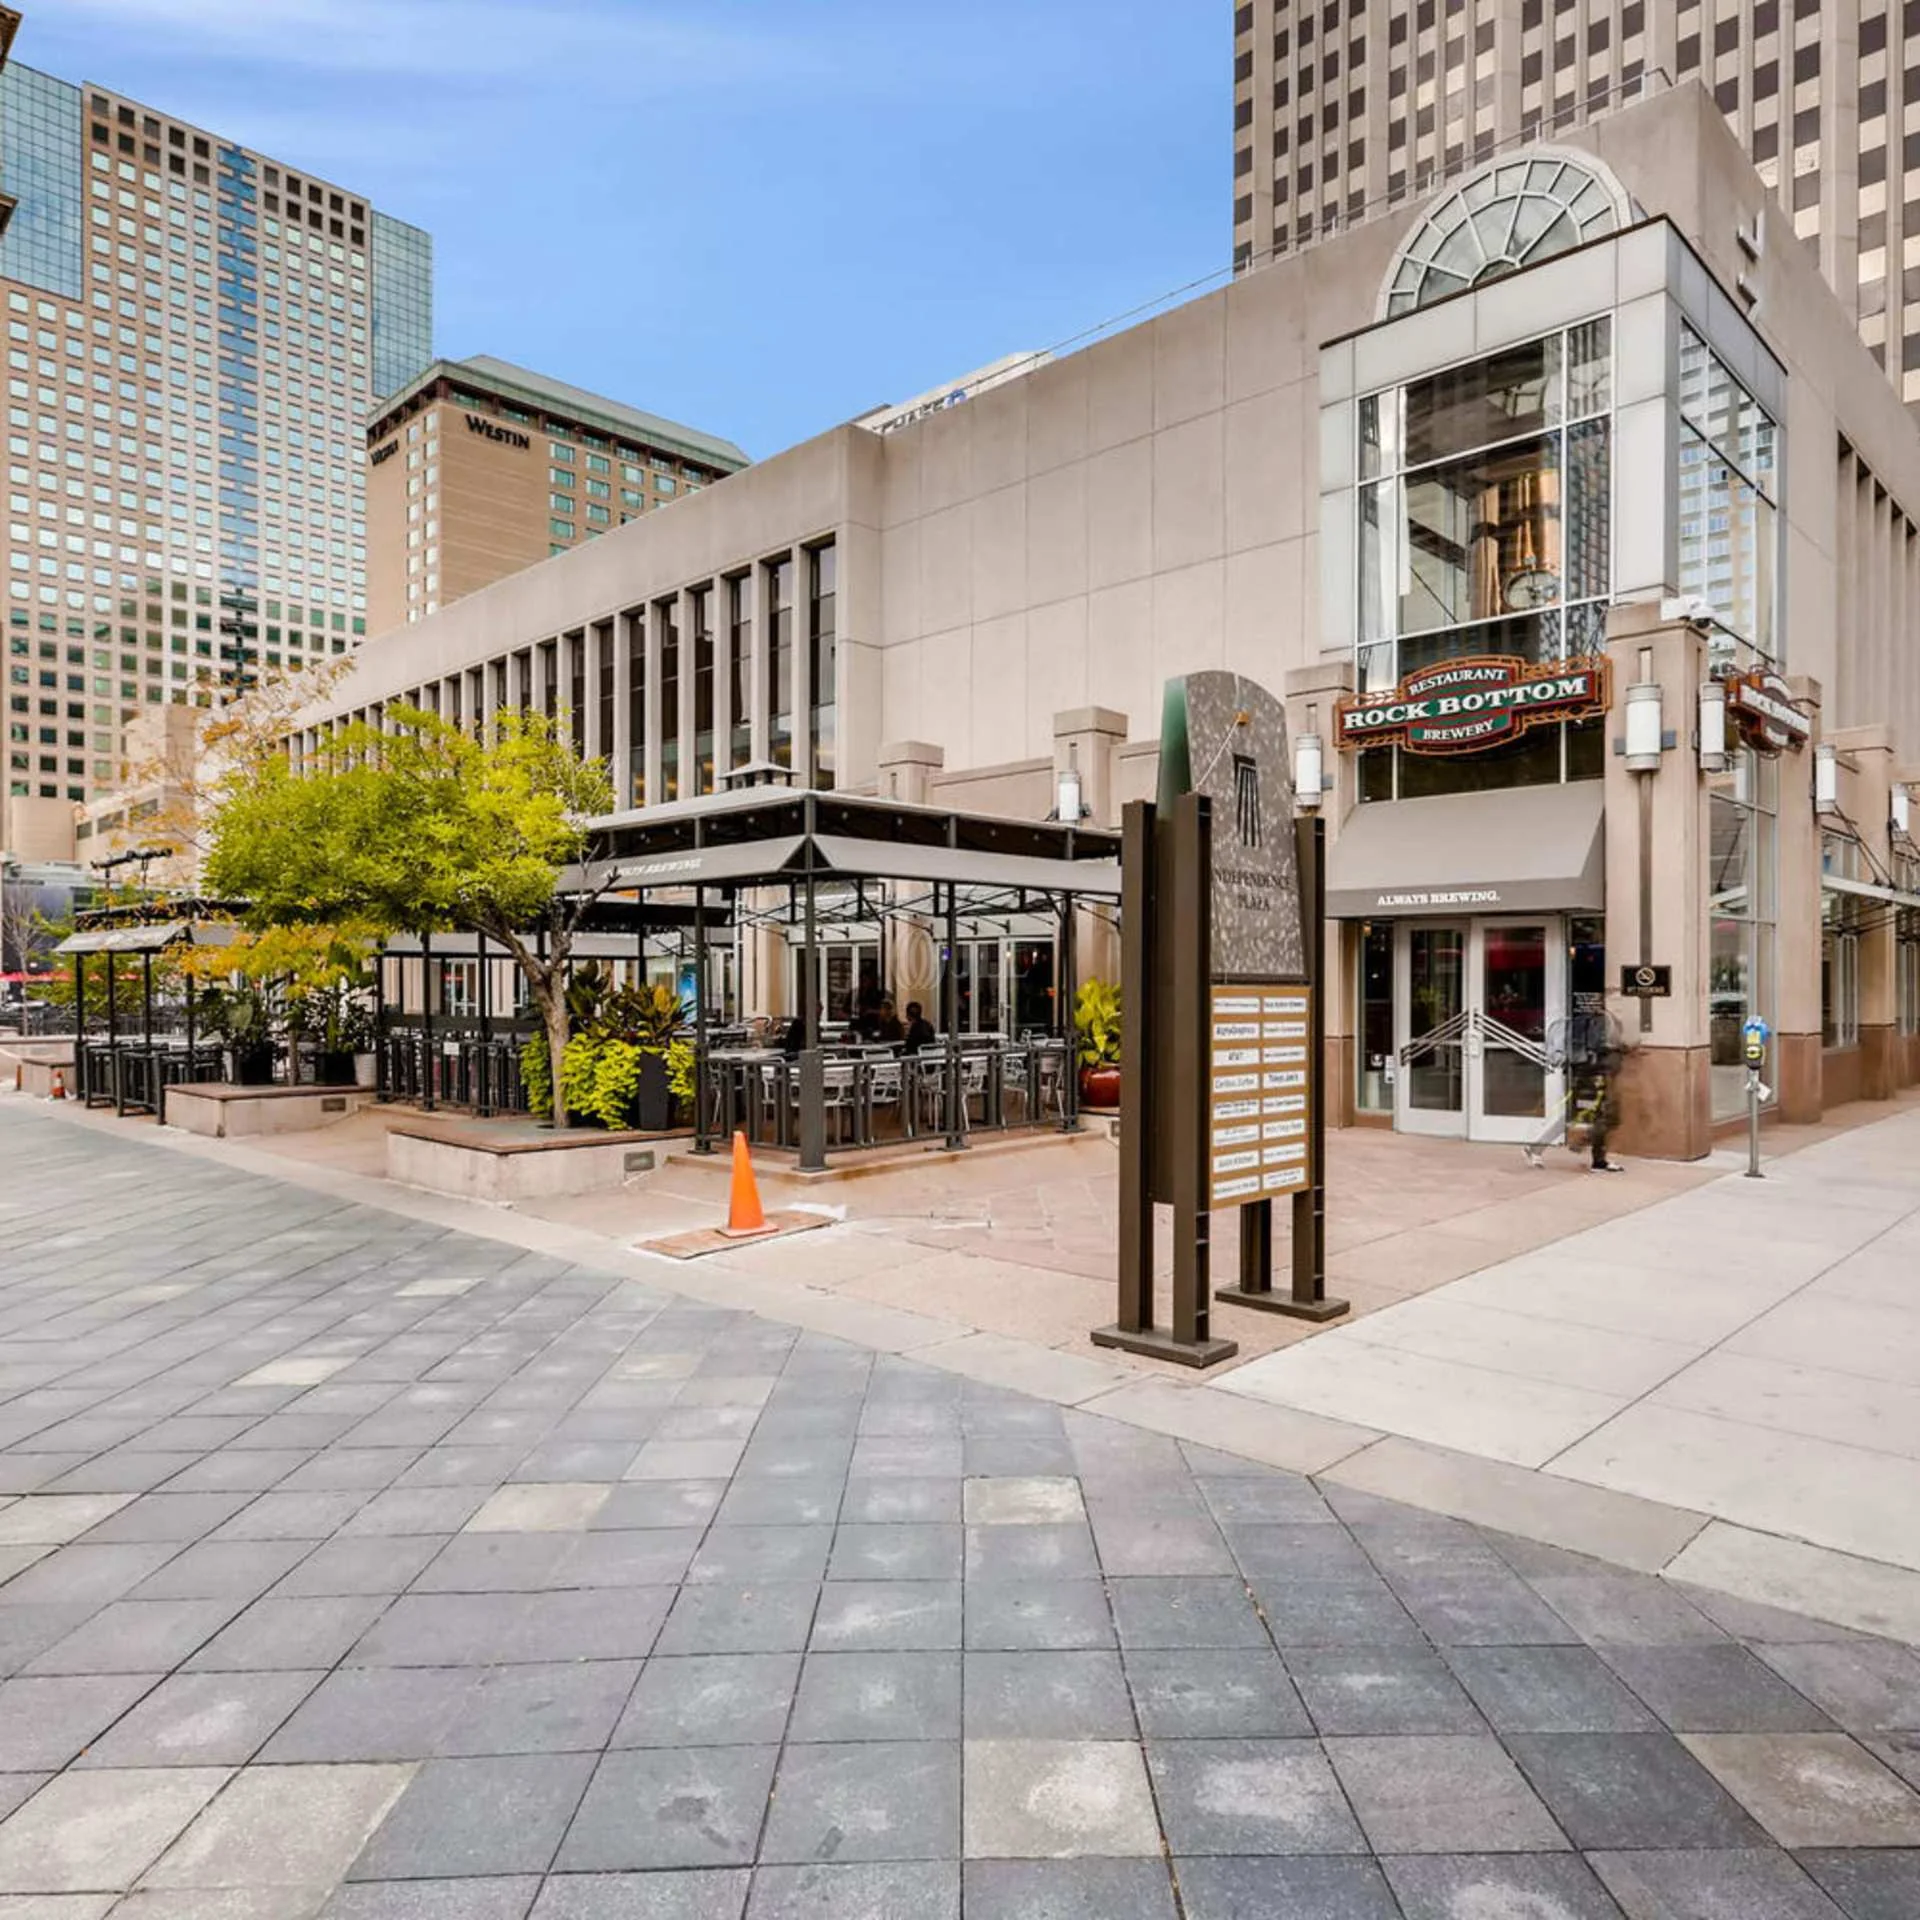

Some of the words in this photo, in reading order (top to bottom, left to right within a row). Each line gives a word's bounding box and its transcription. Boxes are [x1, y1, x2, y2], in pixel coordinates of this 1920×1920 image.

[464, 414, 530, 449] WESTIN
[1408, 668, 1507, 696] RESTAURANT
[1343, 701, 1431, 729] ROCK
[1440, 677, 1587, 714] BOTTOM
[1423, 719, 1494, 741] BREWERY
[1238, 894, 1271, 912] PLAZA
[1377, 893, 1429, 906] ALWAYS
